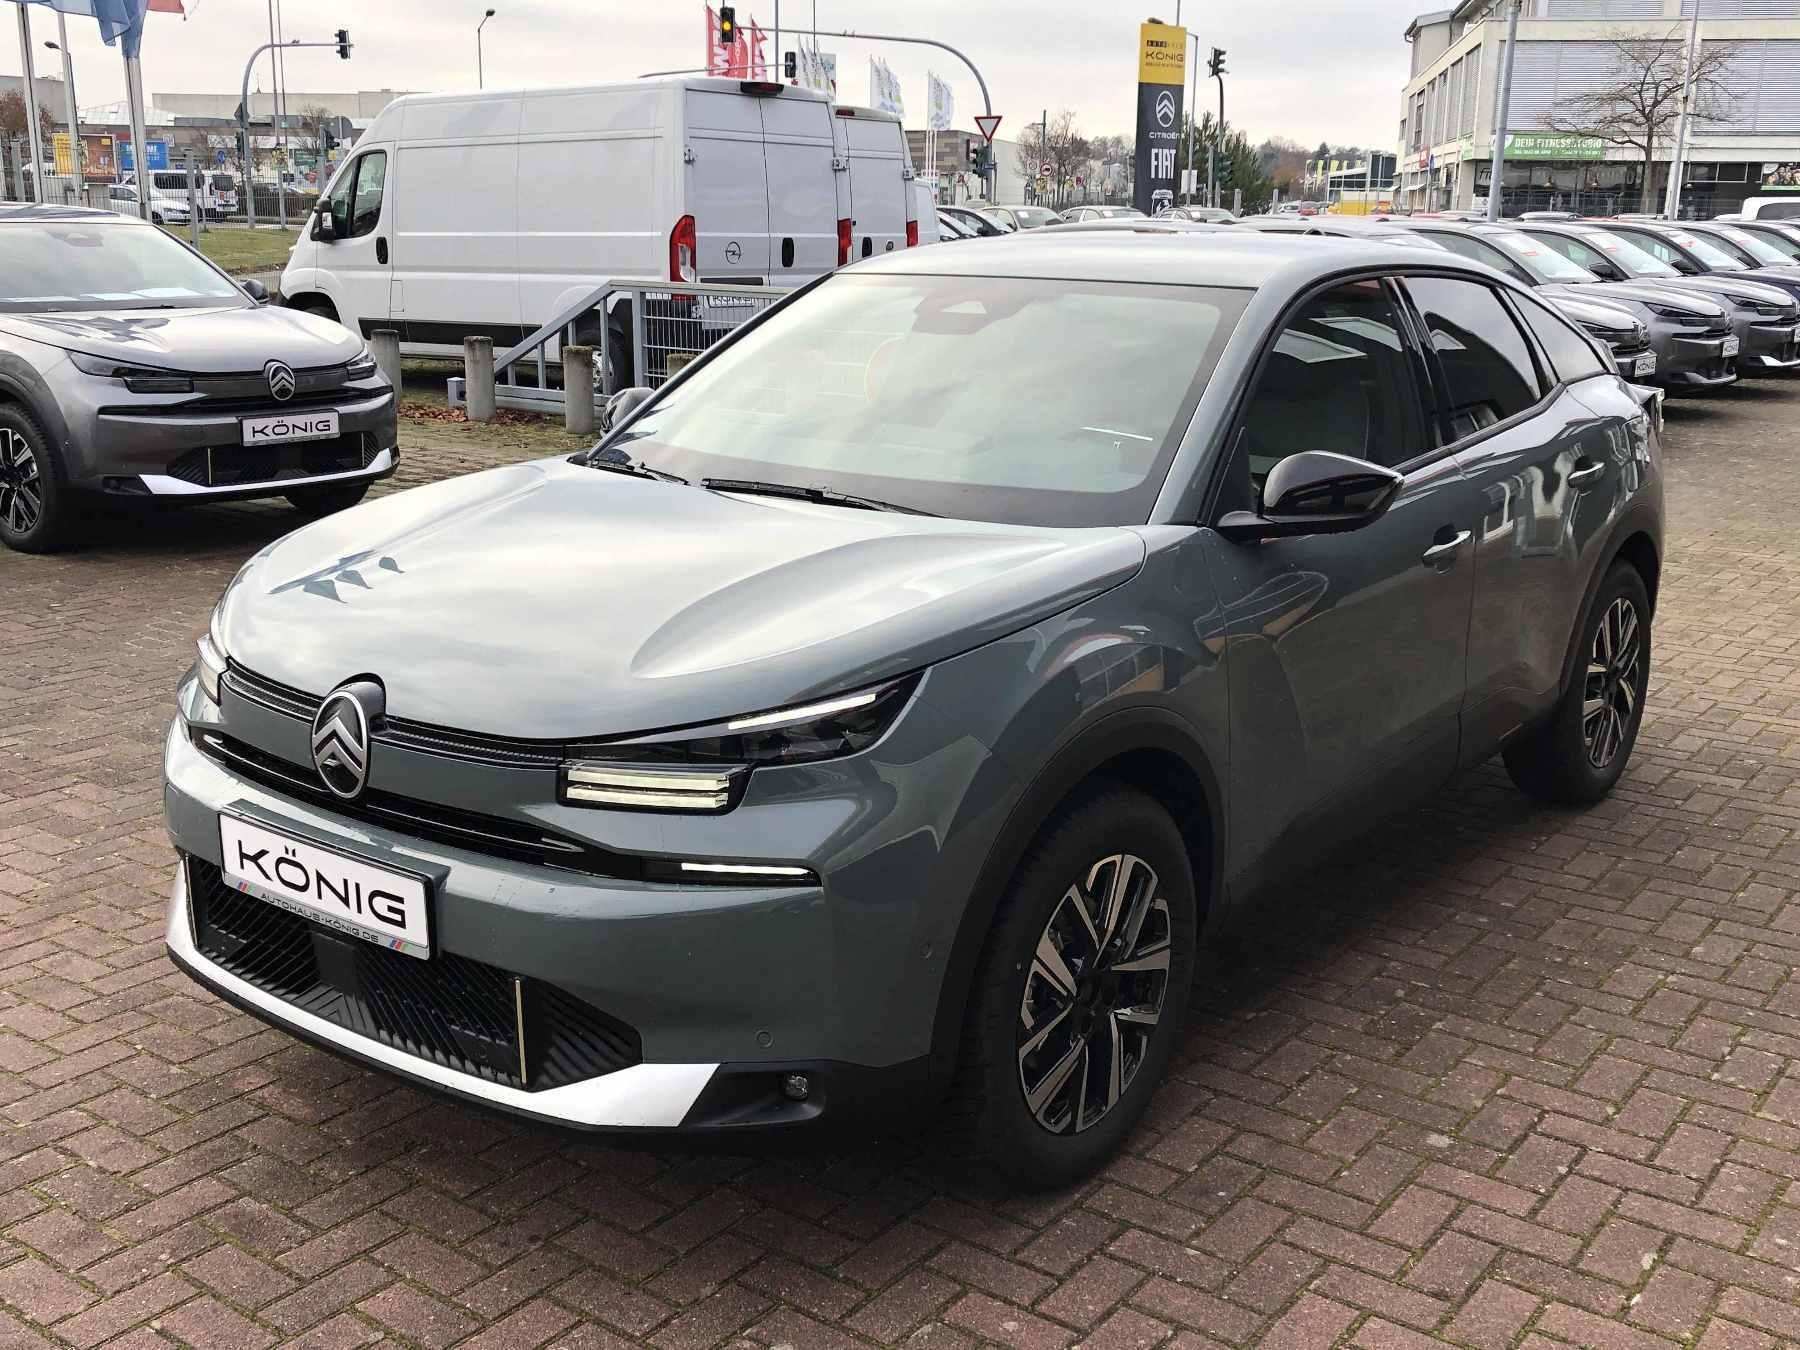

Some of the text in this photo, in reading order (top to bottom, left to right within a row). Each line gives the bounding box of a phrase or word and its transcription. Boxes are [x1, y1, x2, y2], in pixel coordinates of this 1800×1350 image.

[1151, 148, 1176, 179] FIAT
[252, 419, 331, 438] KÖNIG
[237, 839, 407, 930] KÖNIG
